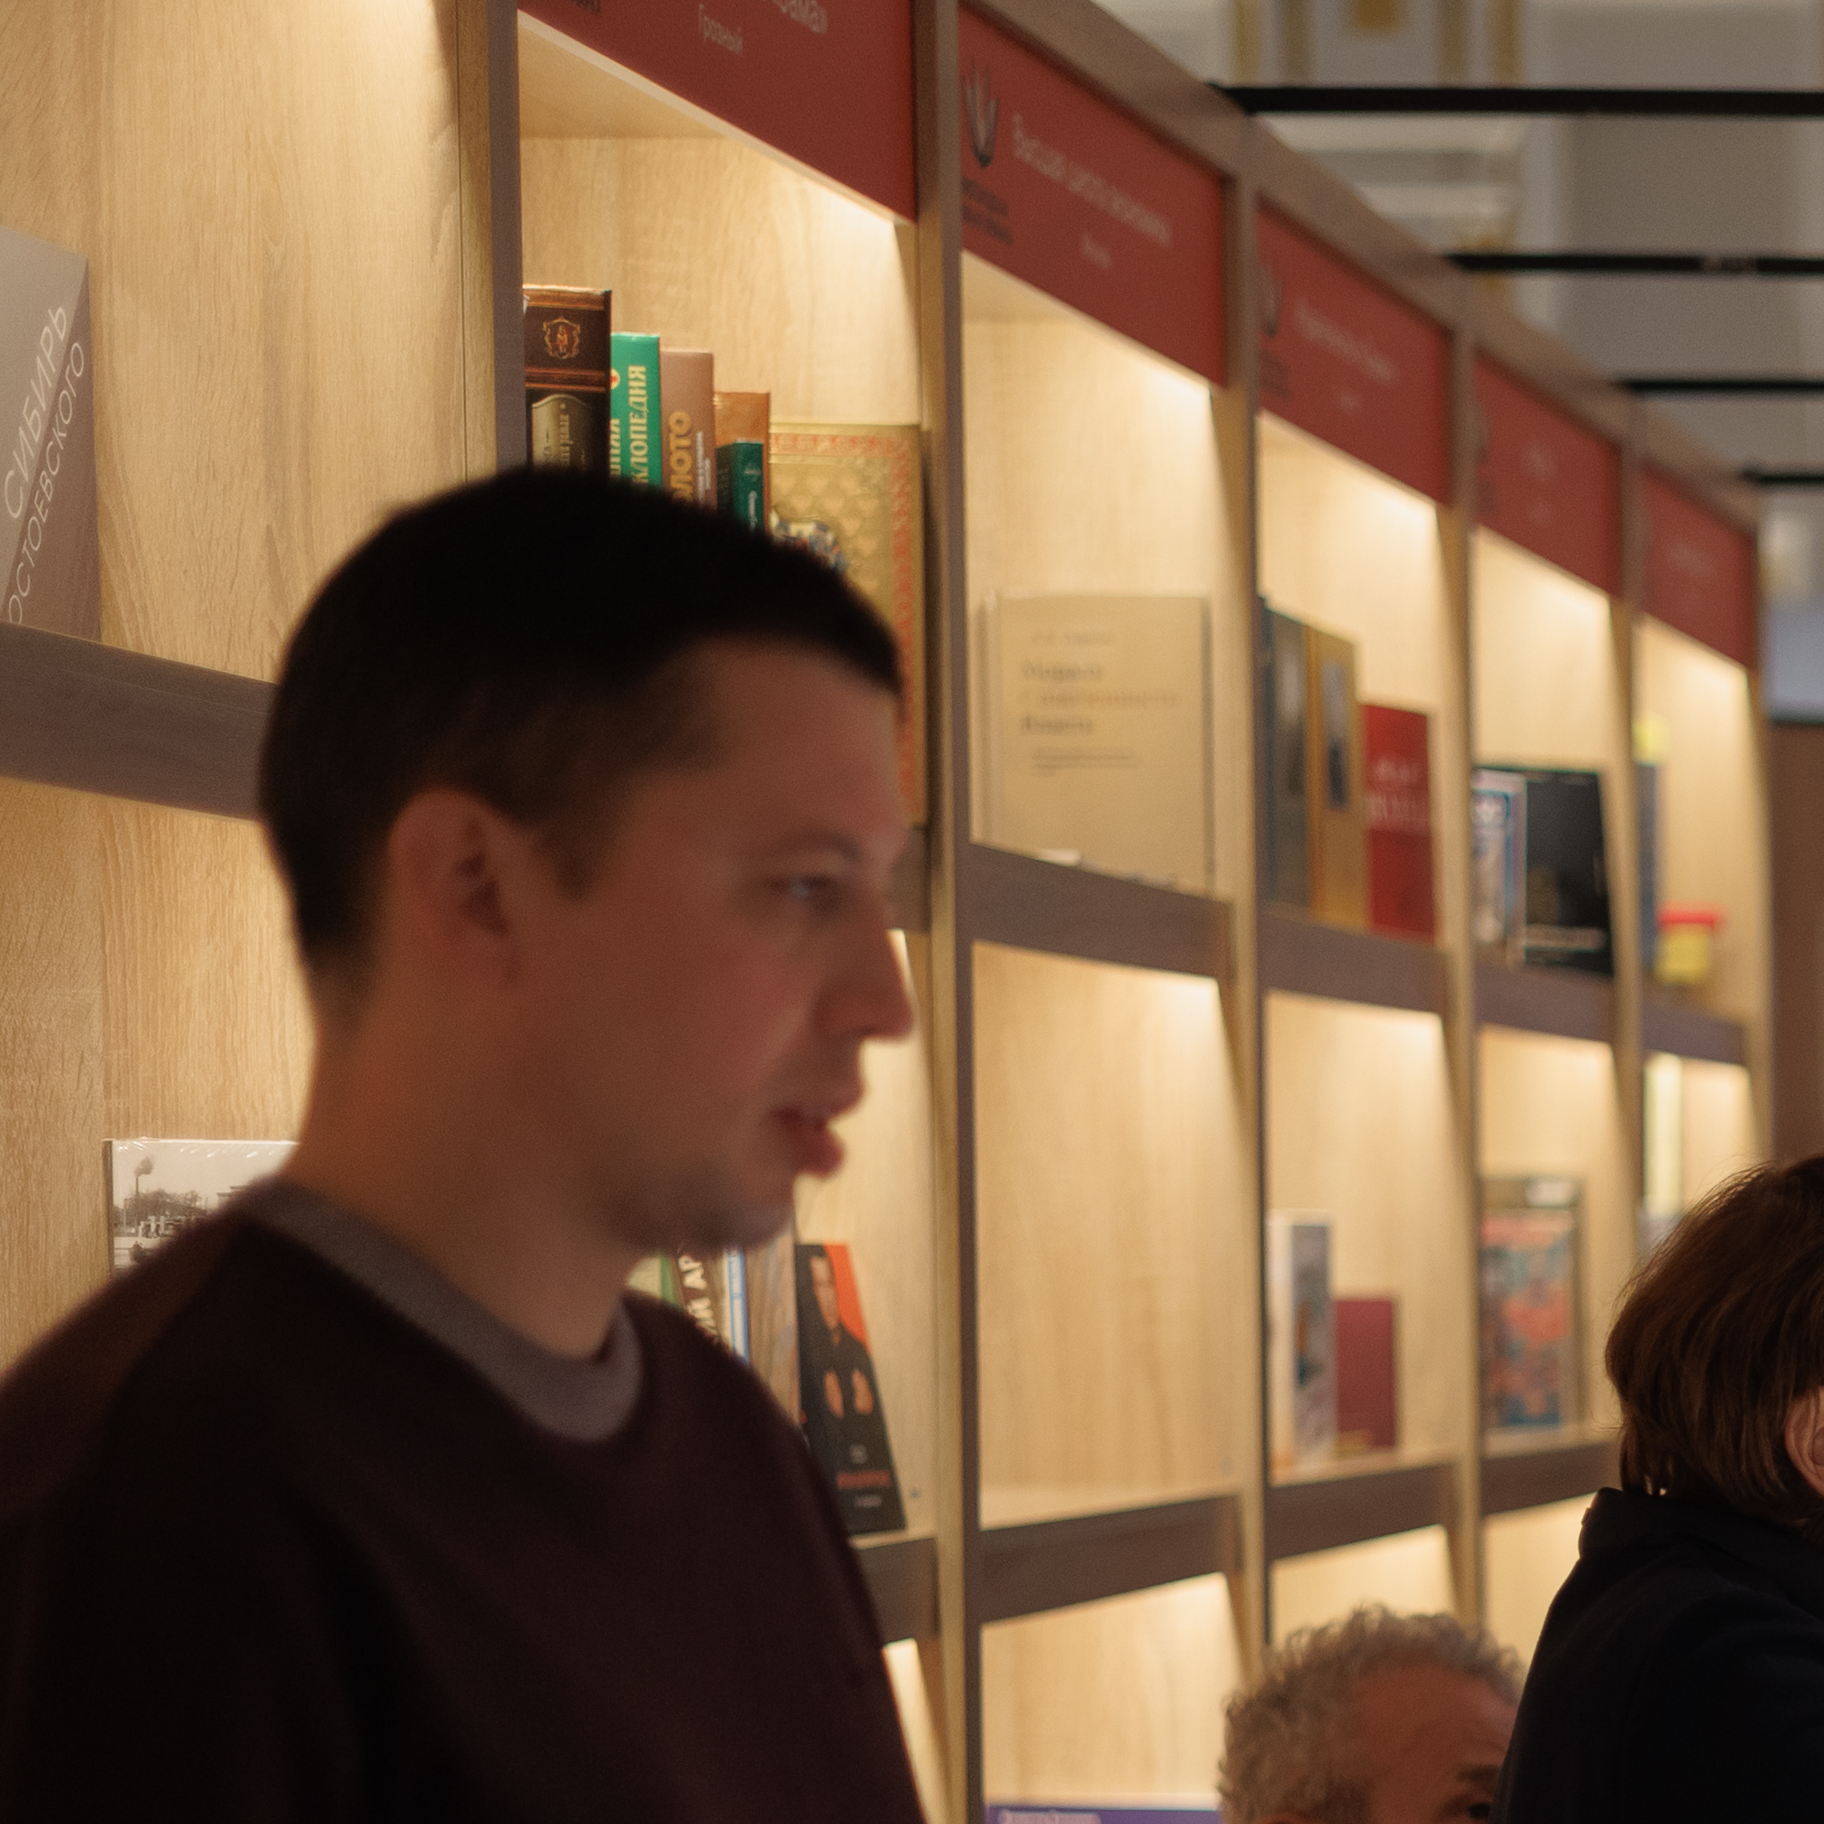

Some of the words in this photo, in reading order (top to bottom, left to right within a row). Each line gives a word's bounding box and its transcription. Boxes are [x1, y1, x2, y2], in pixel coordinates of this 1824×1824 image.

[4, 306, 68, 520] СИБИРЬ
[8, 342, 85, 624] ОСТОЕВСКОГО
[627, 365, 649, 484] КЛОПЕДИЯ
[669, 411, 694, 501] ЛОТО
